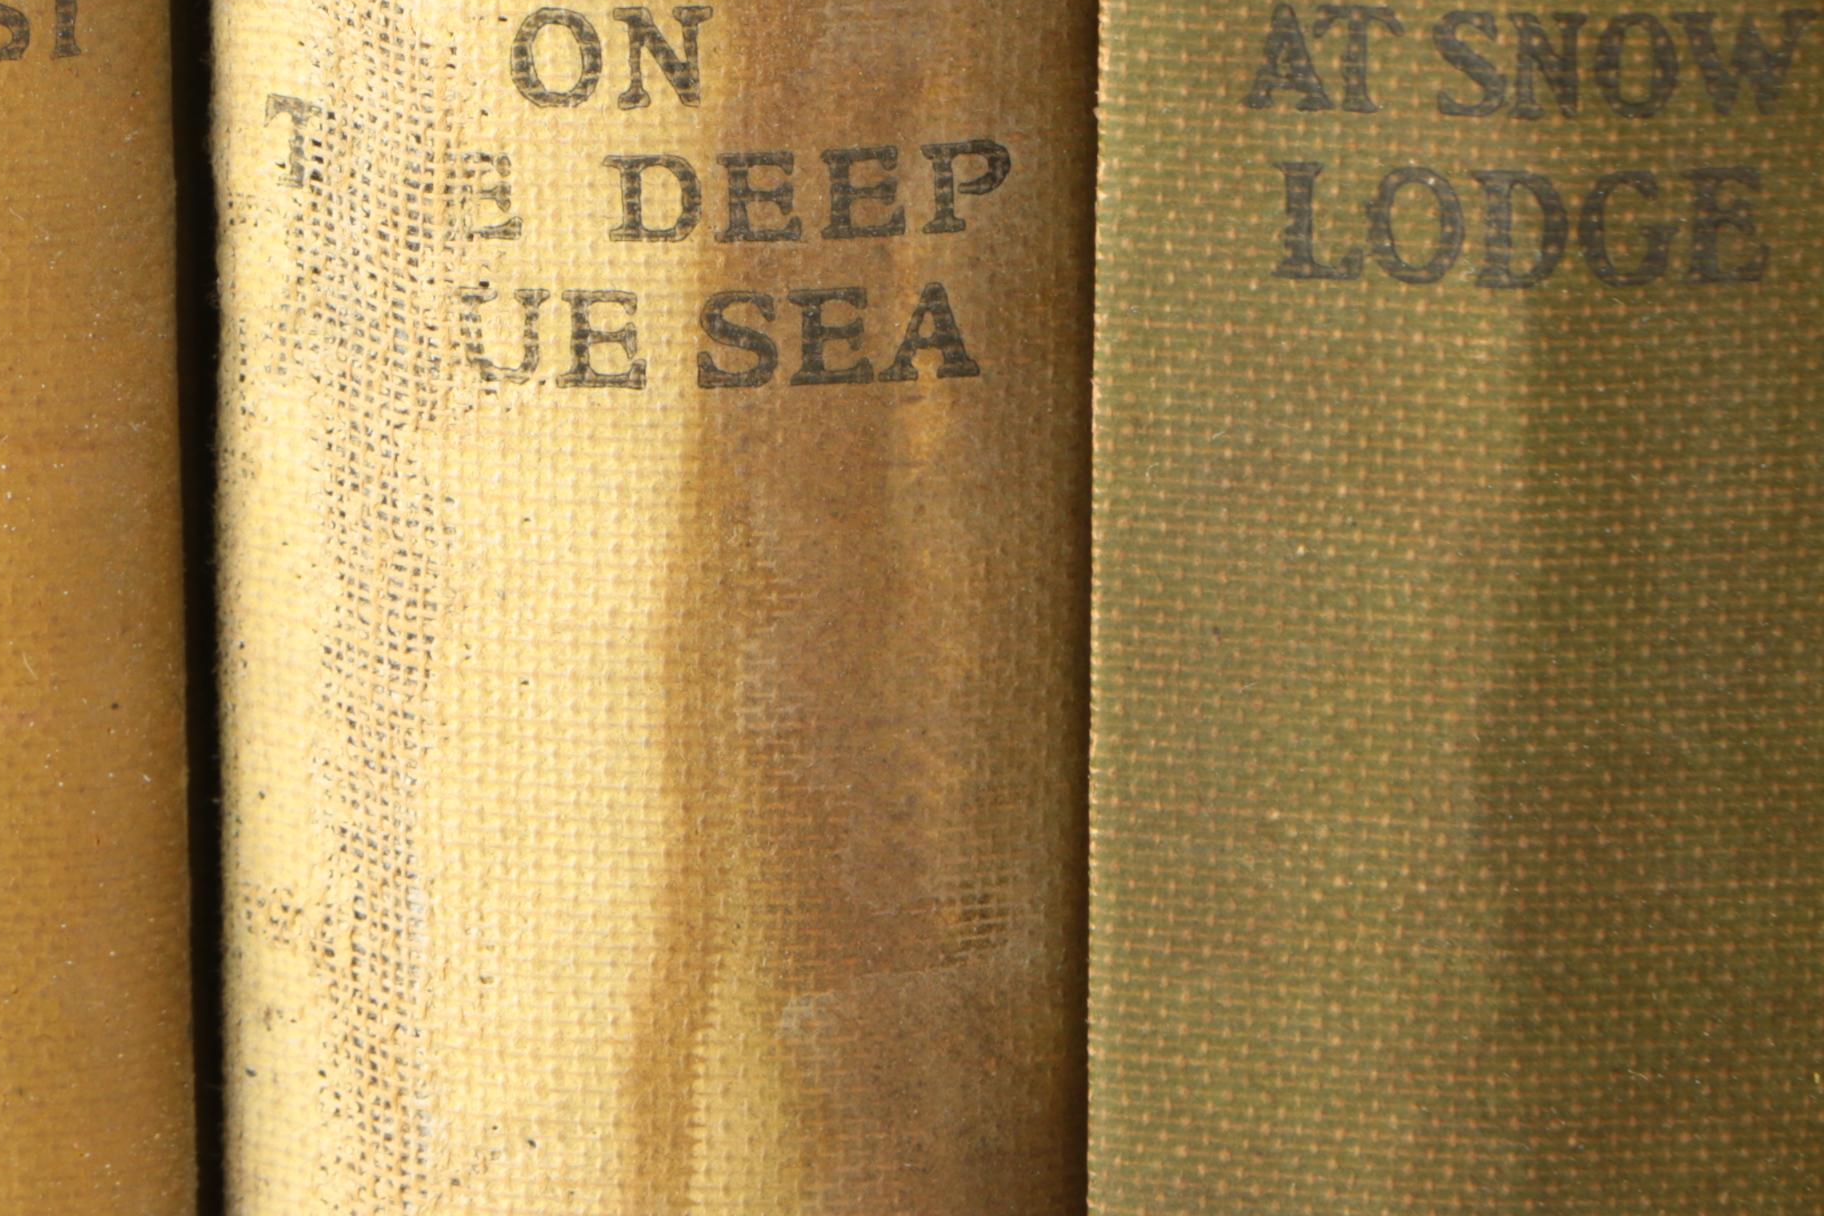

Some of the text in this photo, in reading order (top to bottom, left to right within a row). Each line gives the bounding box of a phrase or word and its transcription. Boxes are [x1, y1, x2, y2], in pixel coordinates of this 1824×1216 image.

[509, 4, 713, 110] ON
[1242, 2, 1822, 120] AT SNOW
[264, 92, 1014, 242] TE DEEP
[1270, 160, 1771, 289] LODGE
[695, 281, 980, 389] SEA
